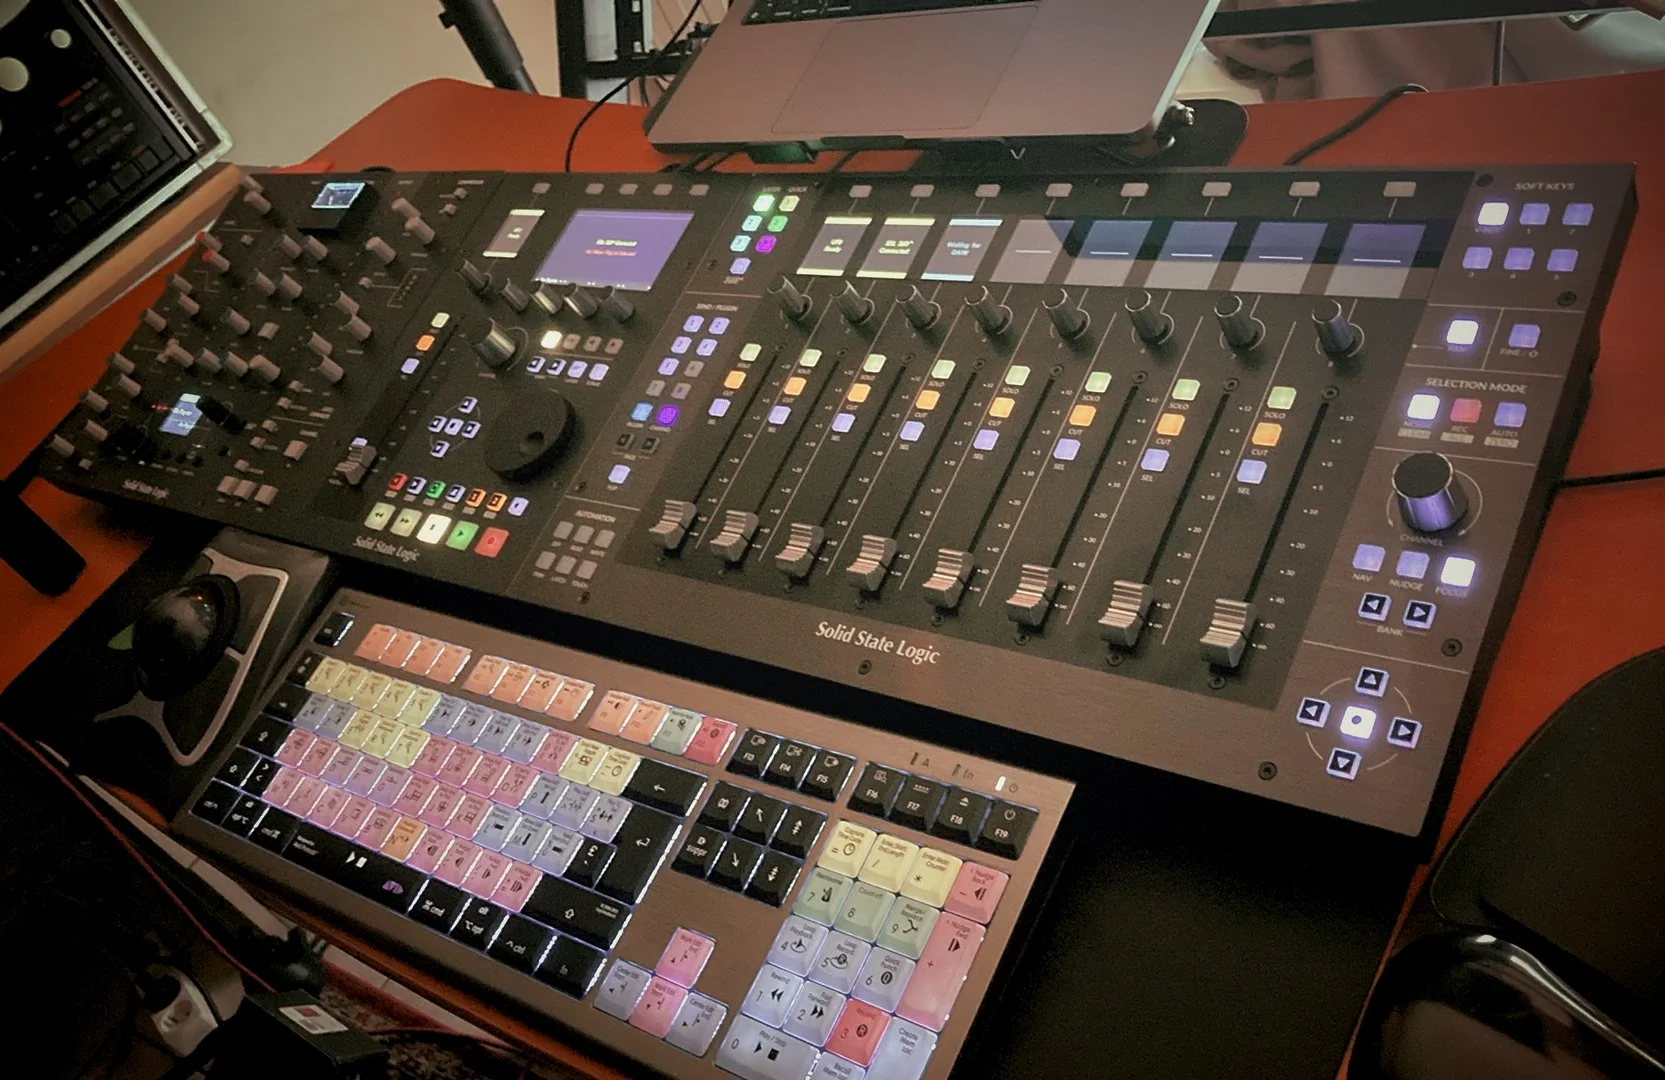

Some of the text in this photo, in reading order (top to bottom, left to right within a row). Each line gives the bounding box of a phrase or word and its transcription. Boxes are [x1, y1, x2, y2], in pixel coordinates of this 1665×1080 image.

[1515, 182, 1575, 191] SOFT KEYS
[1425, 377, 1528, 394] SELECTION MODE
[1491, 429, 1518, 438] AUTO
[1400, 534, 1444, 547] CHANNEL
[352, 536, 420, 562] Solid State Logic
[1352, 573, 1373, 582] NAV
[1389, 579, 1423, 591] NUDGE
[1435, 586, 1469, 598] FOCUS
[1376, 625, 1404, 636] BANK
[815, 621, 940, 665] Solid State Logic
[780, 763, 791, 772] F14
[816, 774, 829, 784] F15
[866, 789, 879, 800] F16
[907, 801, 920, 811] F17
[950, 814, 964, 825] F18
[994, 828, 1009, 839] F19
[807, 893, 815, 902] 7
[848, 908, 856, 918] 8
[891, 923, 899, 933] 9
[780, 940, 788, 951] 4
[821, 957, 831, 968] 5
[866, 975, 873, 985] 6
[797, 1010, 805, 1021] 2
[840, 1028, 849, 1039] 3
[731, 1039, 739, 1050] 0
